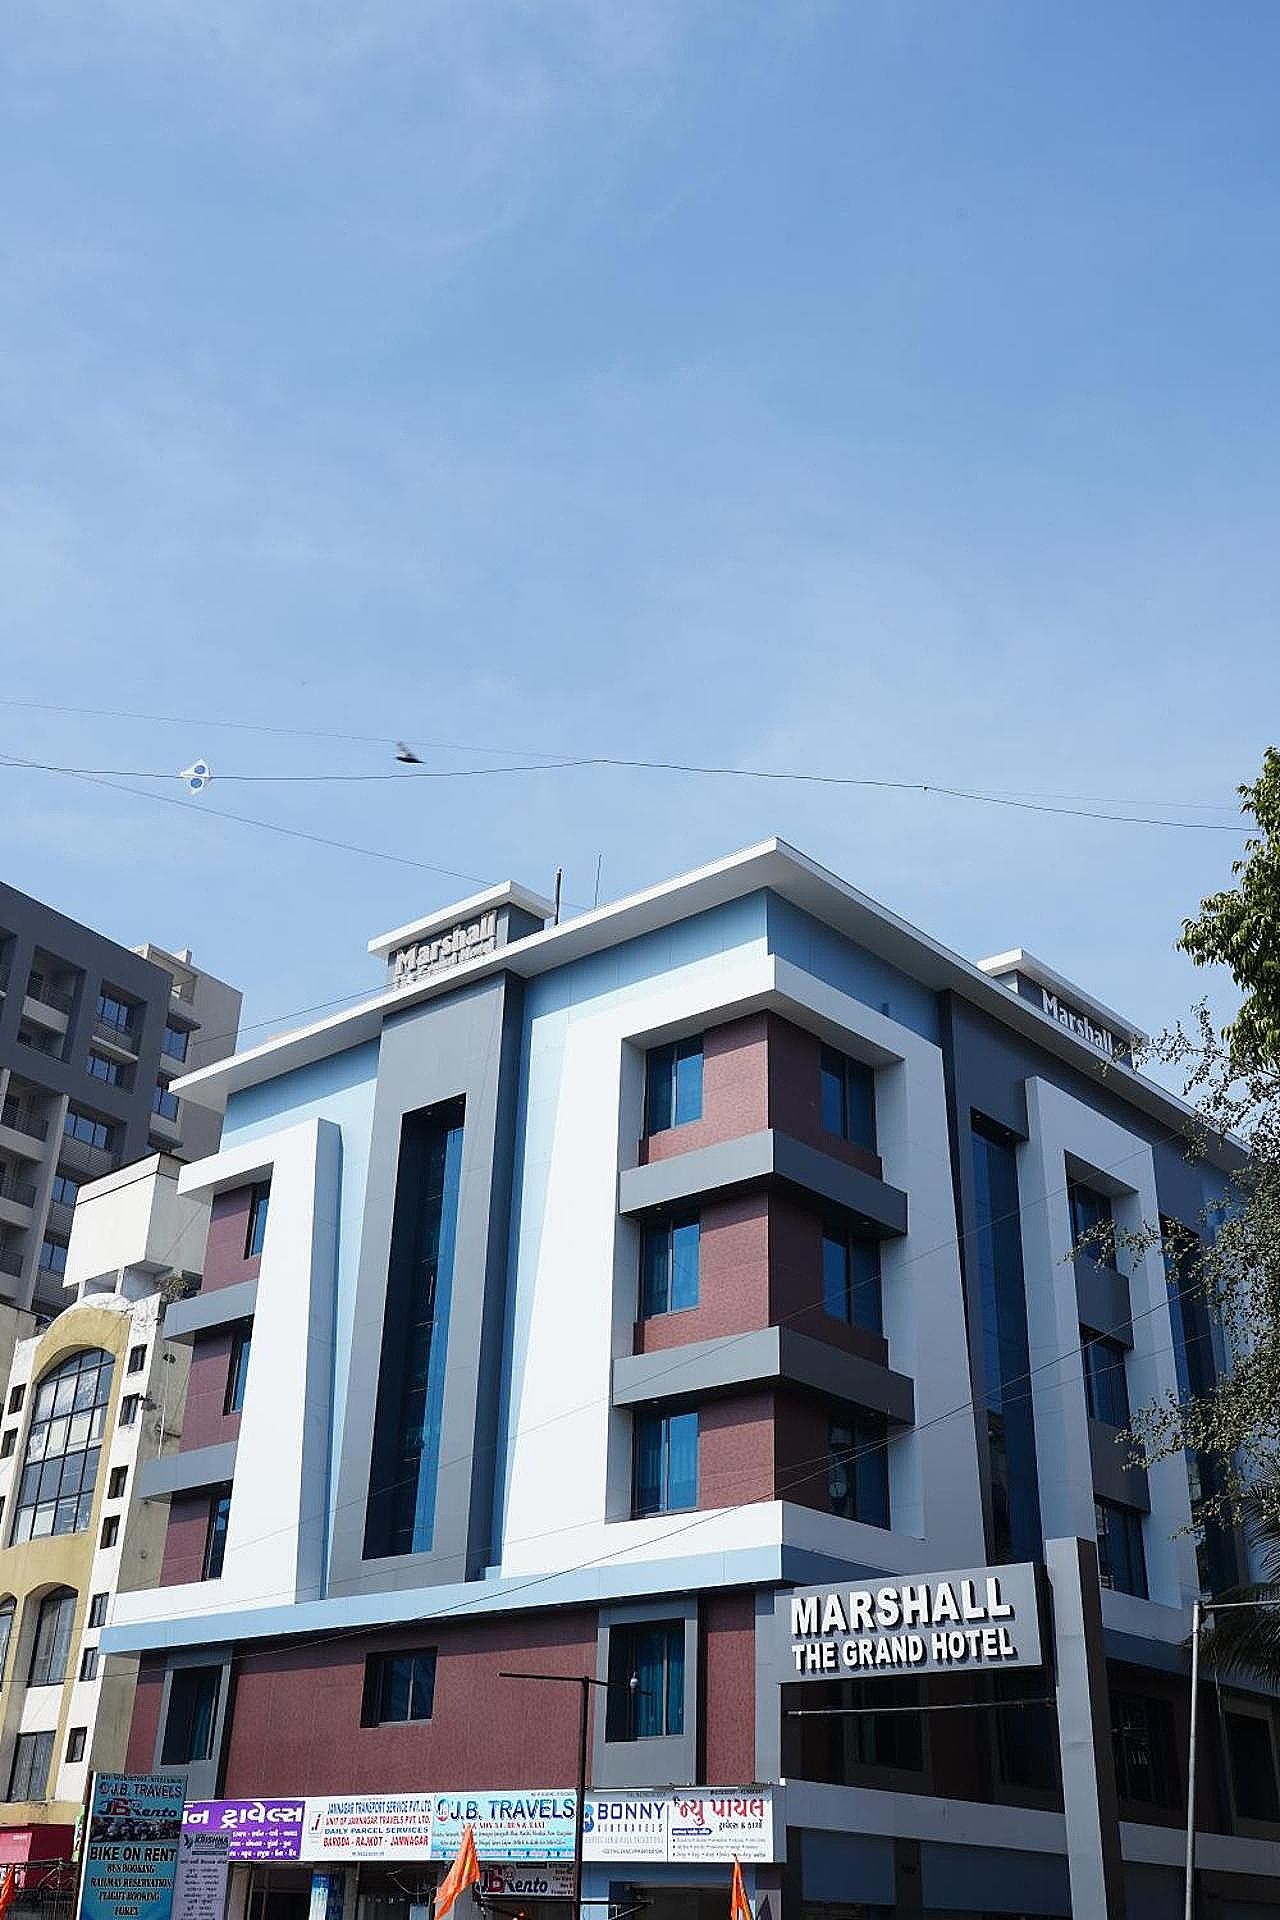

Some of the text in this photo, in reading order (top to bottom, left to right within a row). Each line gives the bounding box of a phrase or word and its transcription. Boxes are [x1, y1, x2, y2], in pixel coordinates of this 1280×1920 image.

[395, 909, 498, 976] Marshall
[1041, 988, 1113, 1056] Marshall
[791, 1577, 1012, 1635] MARSHALL
[791, 1627, 1015, 1670] THE GRAND HOTEL
[131, 1783, 182, 1798] TRAVELS
[220, 1802, 303, 1828] ટ્રાવેલ્સ
[355, 1801, 385, 1814] TRANSPORT
[386, 1801, 408, 1813] SERVICE
[488, 1798, 576, 1820] TRAVELS
[598, 1802, 665, 1820] BONNY
[711, 1799, 764, 1818] પાયલ
[379, 1816, 403, 1824] TRAVELS
[323, 1837, 349, 1847] BARODA
[355, 1837, 383, 1847] RAJKOT
[90, 1847, 177, 1861] BIKE ON RENT
[122, 1863, 156, 1874] BOOKING
[91, 1878, 174, 1889] RAILWAY RESERVATION
[99, 1892, 160, 1901] FLIGHT BOOKING
